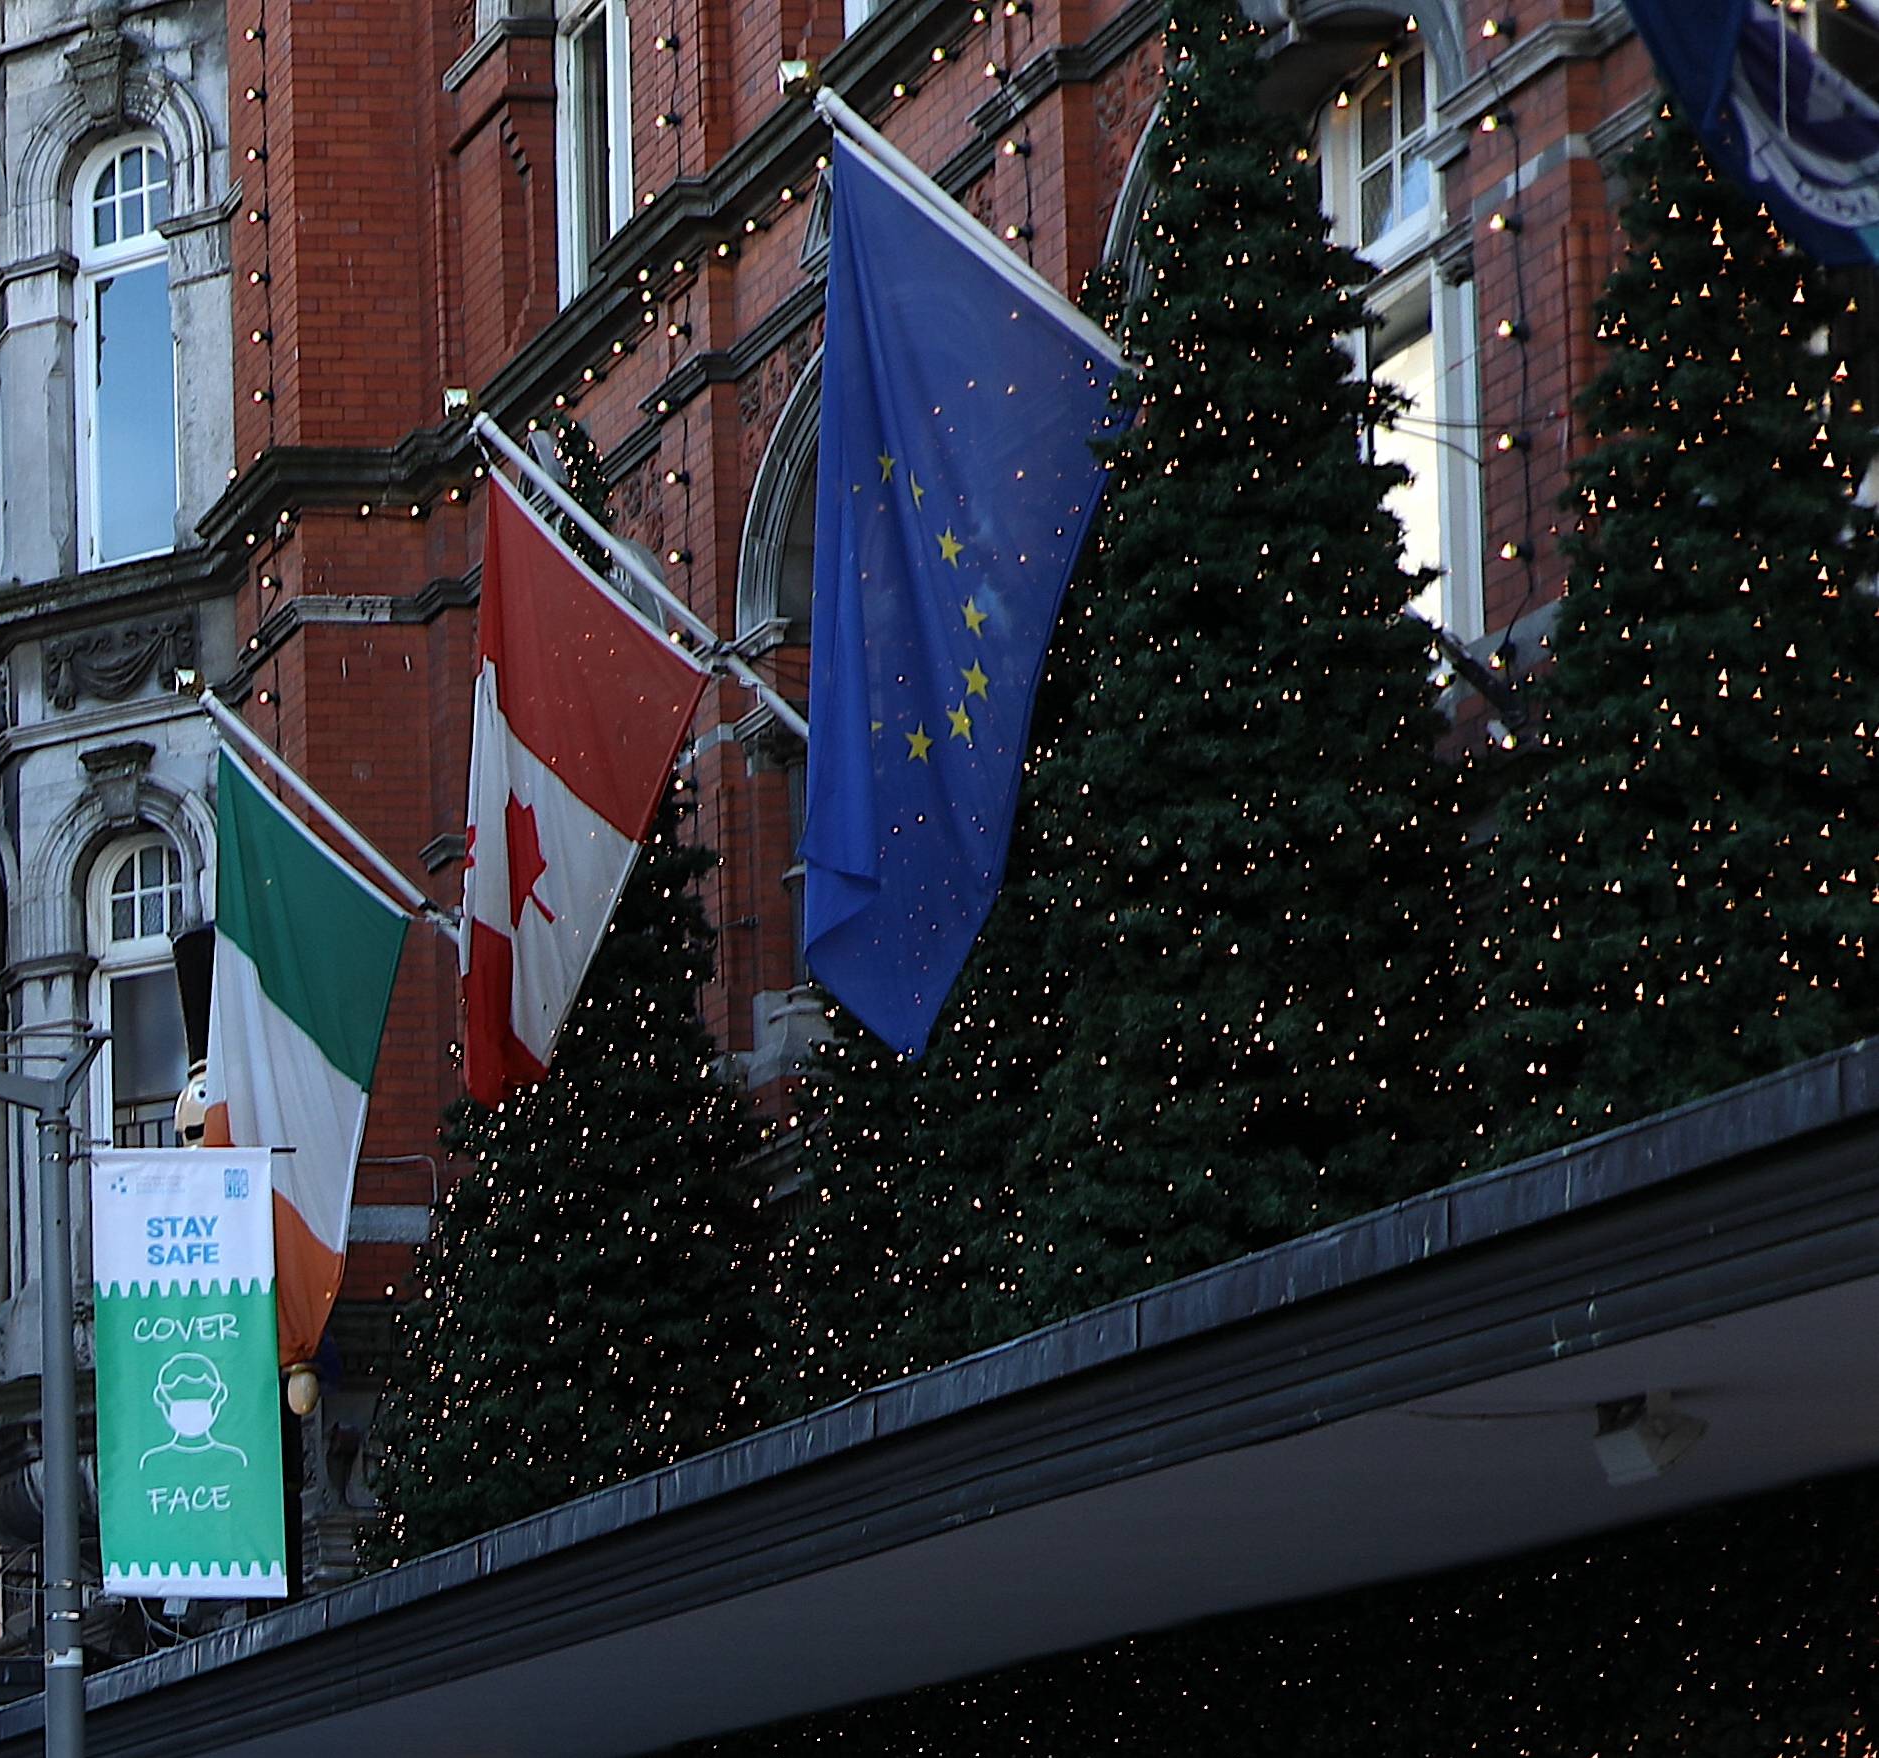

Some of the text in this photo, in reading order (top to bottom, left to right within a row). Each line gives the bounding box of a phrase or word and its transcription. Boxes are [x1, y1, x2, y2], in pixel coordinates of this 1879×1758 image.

[146, 1215, 219, 1239] STAY
[147, 1242, 220, 1266] SAFE
[133, 1313, 241, 1344] COVER
[147, 1484, 232, 1514] FACE
